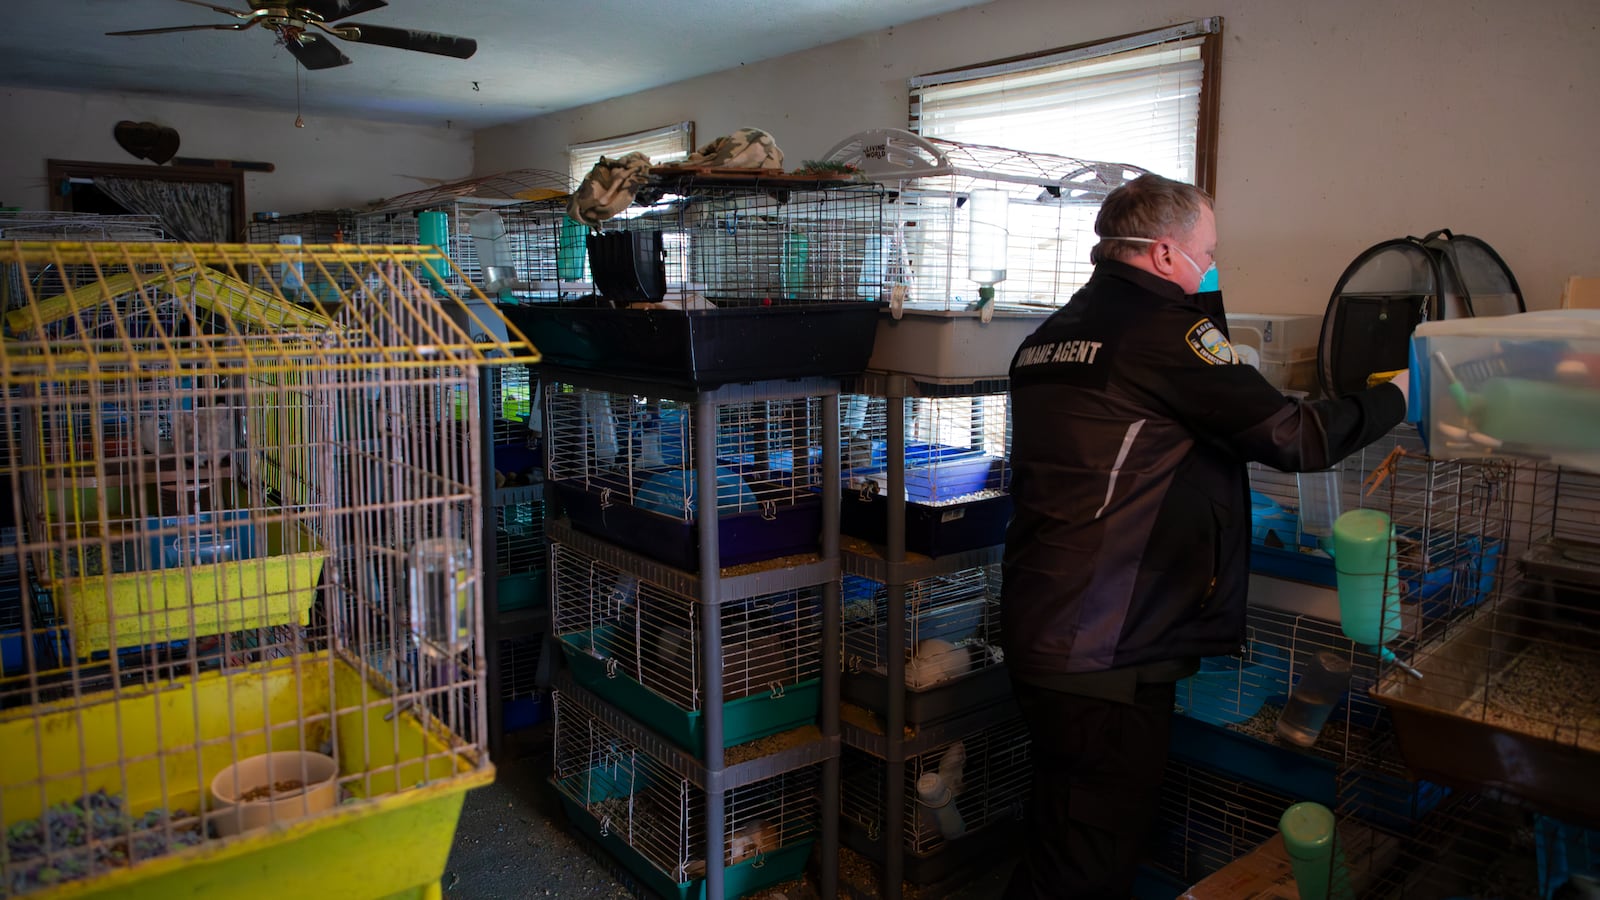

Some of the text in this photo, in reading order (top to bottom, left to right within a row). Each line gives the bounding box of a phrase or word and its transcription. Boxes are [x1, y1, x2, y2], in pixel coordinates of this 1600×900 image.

[866, 144, 885, 152] LIVING
[866, 151, 886, 159] WORLD
[1051, 340, 1103, 365] AGENT
